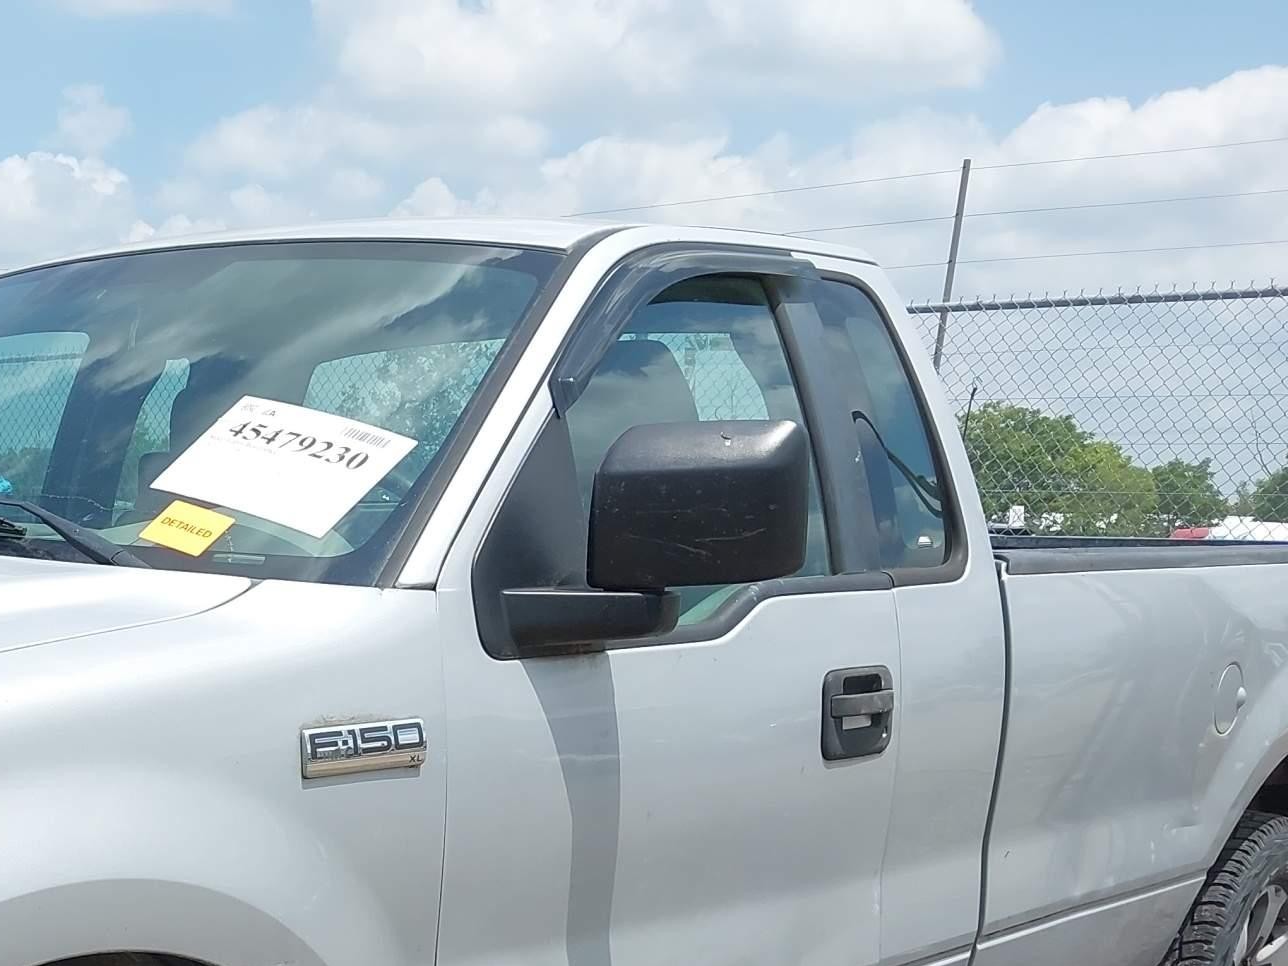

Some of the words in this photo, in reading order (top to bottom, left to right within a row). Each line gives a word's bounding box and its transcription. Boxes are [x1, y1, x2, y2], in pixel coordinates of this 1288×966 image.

[228, 420, 369, 471] 45479230
[160, 516, 213, 538] DETAILED
[408, 755, 423, 763] XL
